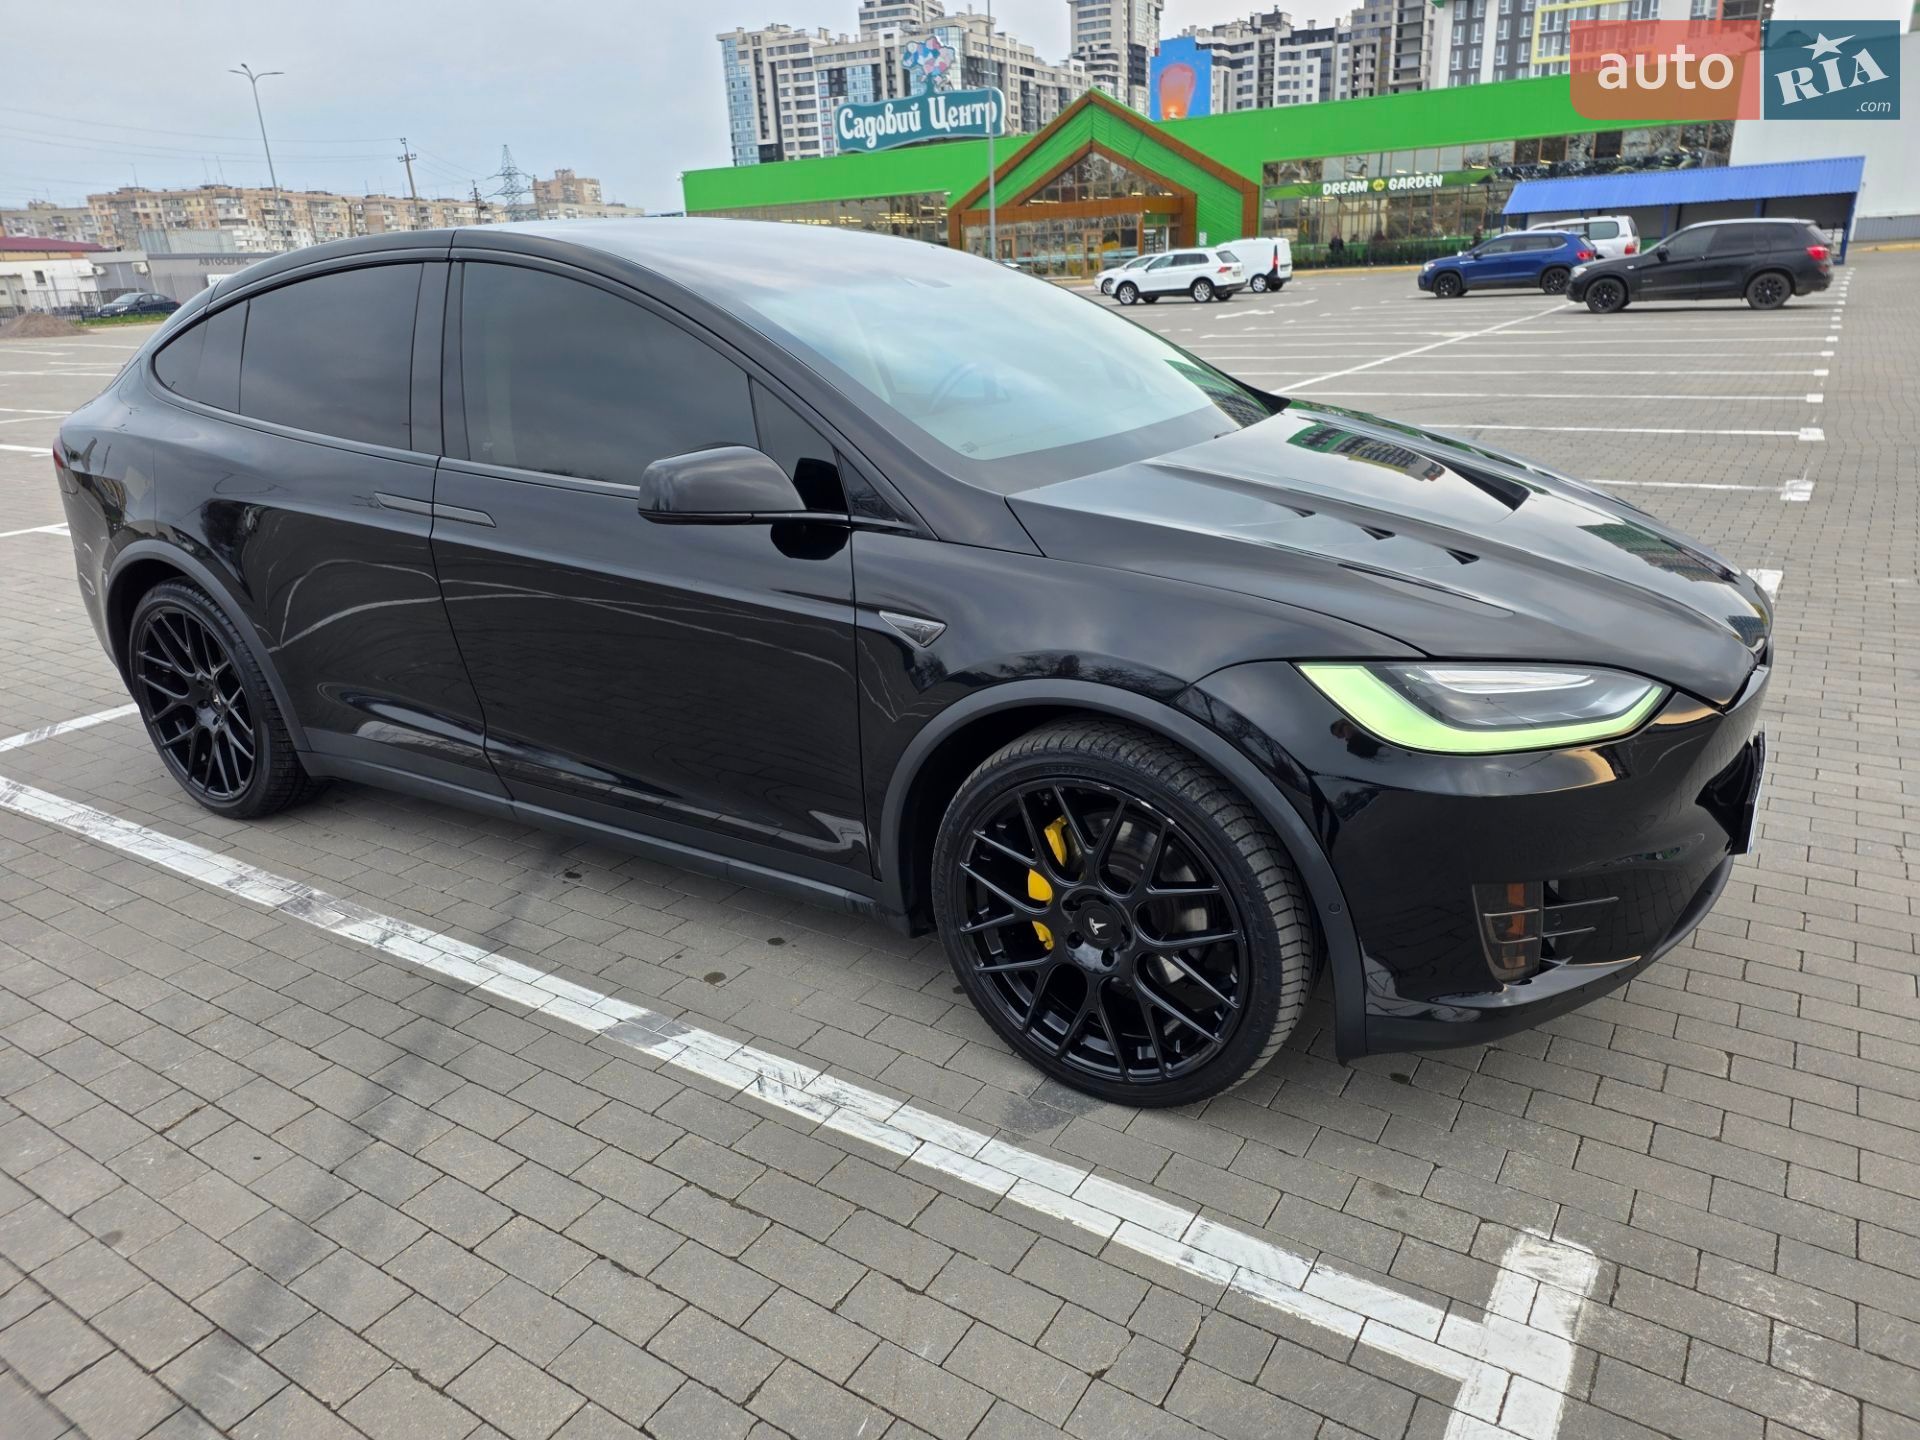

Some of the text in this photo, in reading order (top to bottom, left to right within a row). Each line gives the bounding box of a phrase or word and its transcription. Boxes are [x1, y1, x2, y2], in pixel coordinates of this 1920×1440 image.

[839, 95, 998, 149] Садовий Центр
[1322, 174, 1444, 195] DREAM GARDEN
